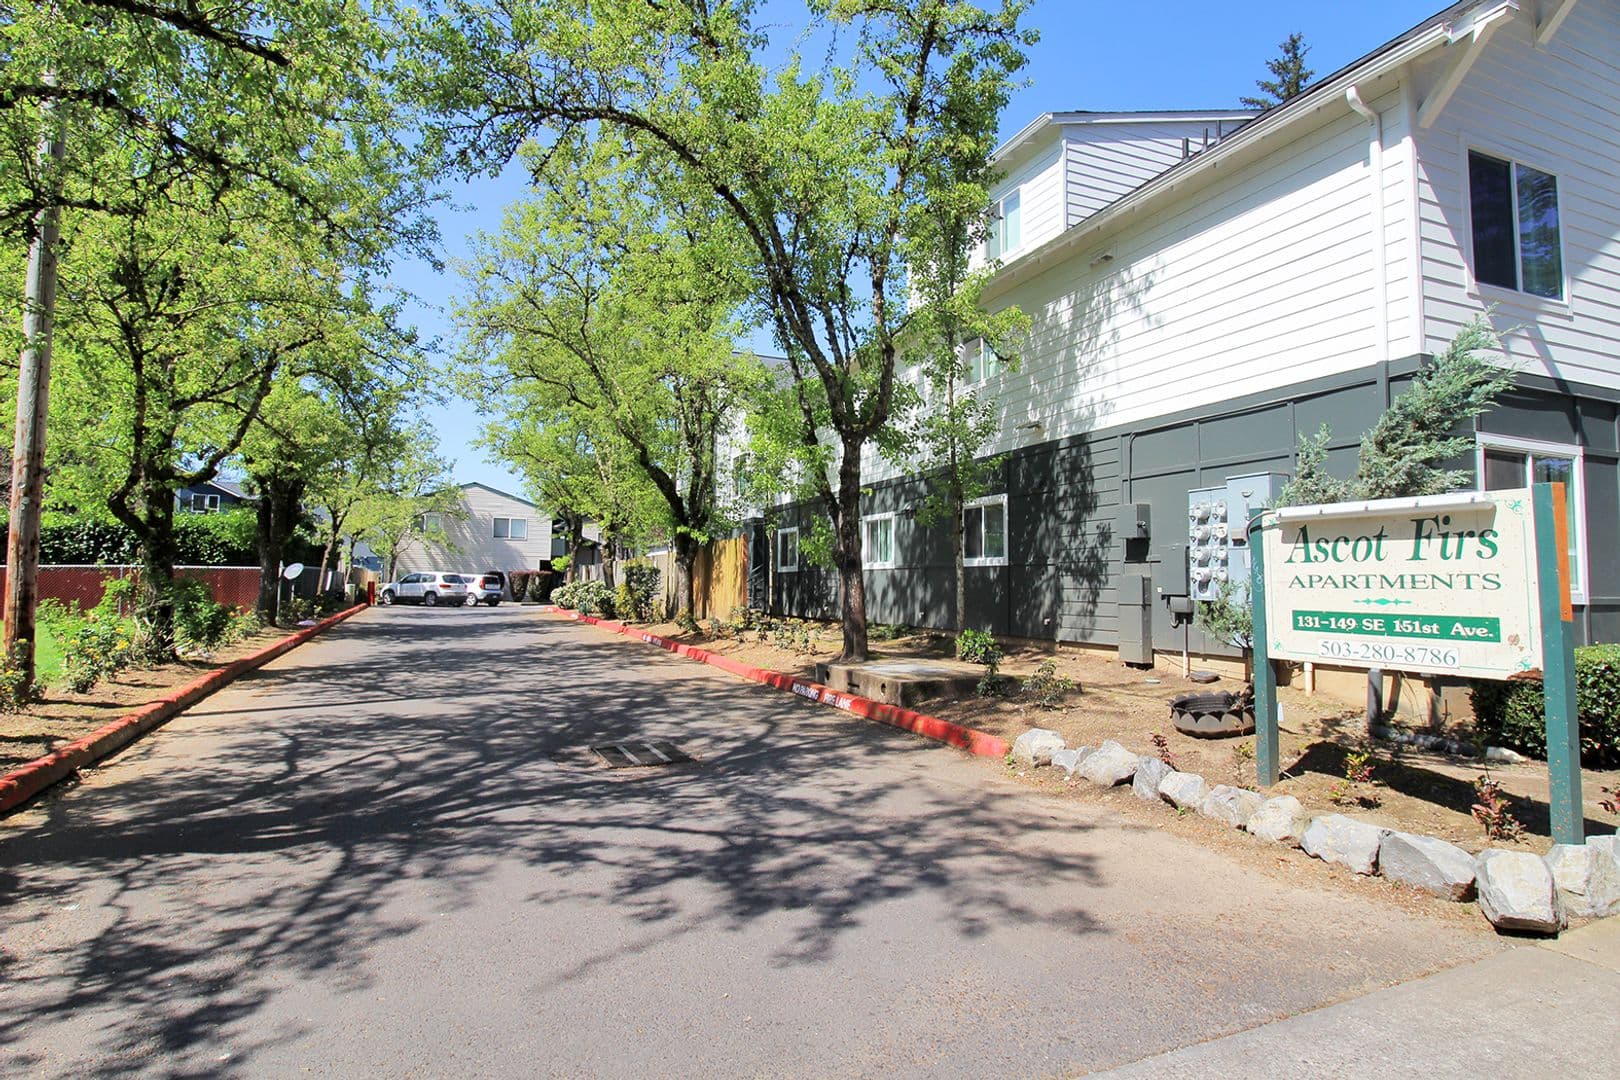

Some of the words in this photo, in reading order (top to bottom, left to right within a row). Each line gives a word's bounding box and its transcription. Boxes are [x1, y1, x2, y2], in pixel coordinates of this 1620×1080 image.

[1285, 524, 1388, 563] Ascot
[1407, 515, 1499, 561] Firs
[1288, 573, 1501, 590] APARTMENTS
[1297, 616, 1358, 631] 131-149
[1362, 618, 1385, 631] SE
[1393, 620, 1440, 635] 151st
[1450, 623, 1494, 638] Ave.
[1321, 641, 1456, 666] 503-280-8786
